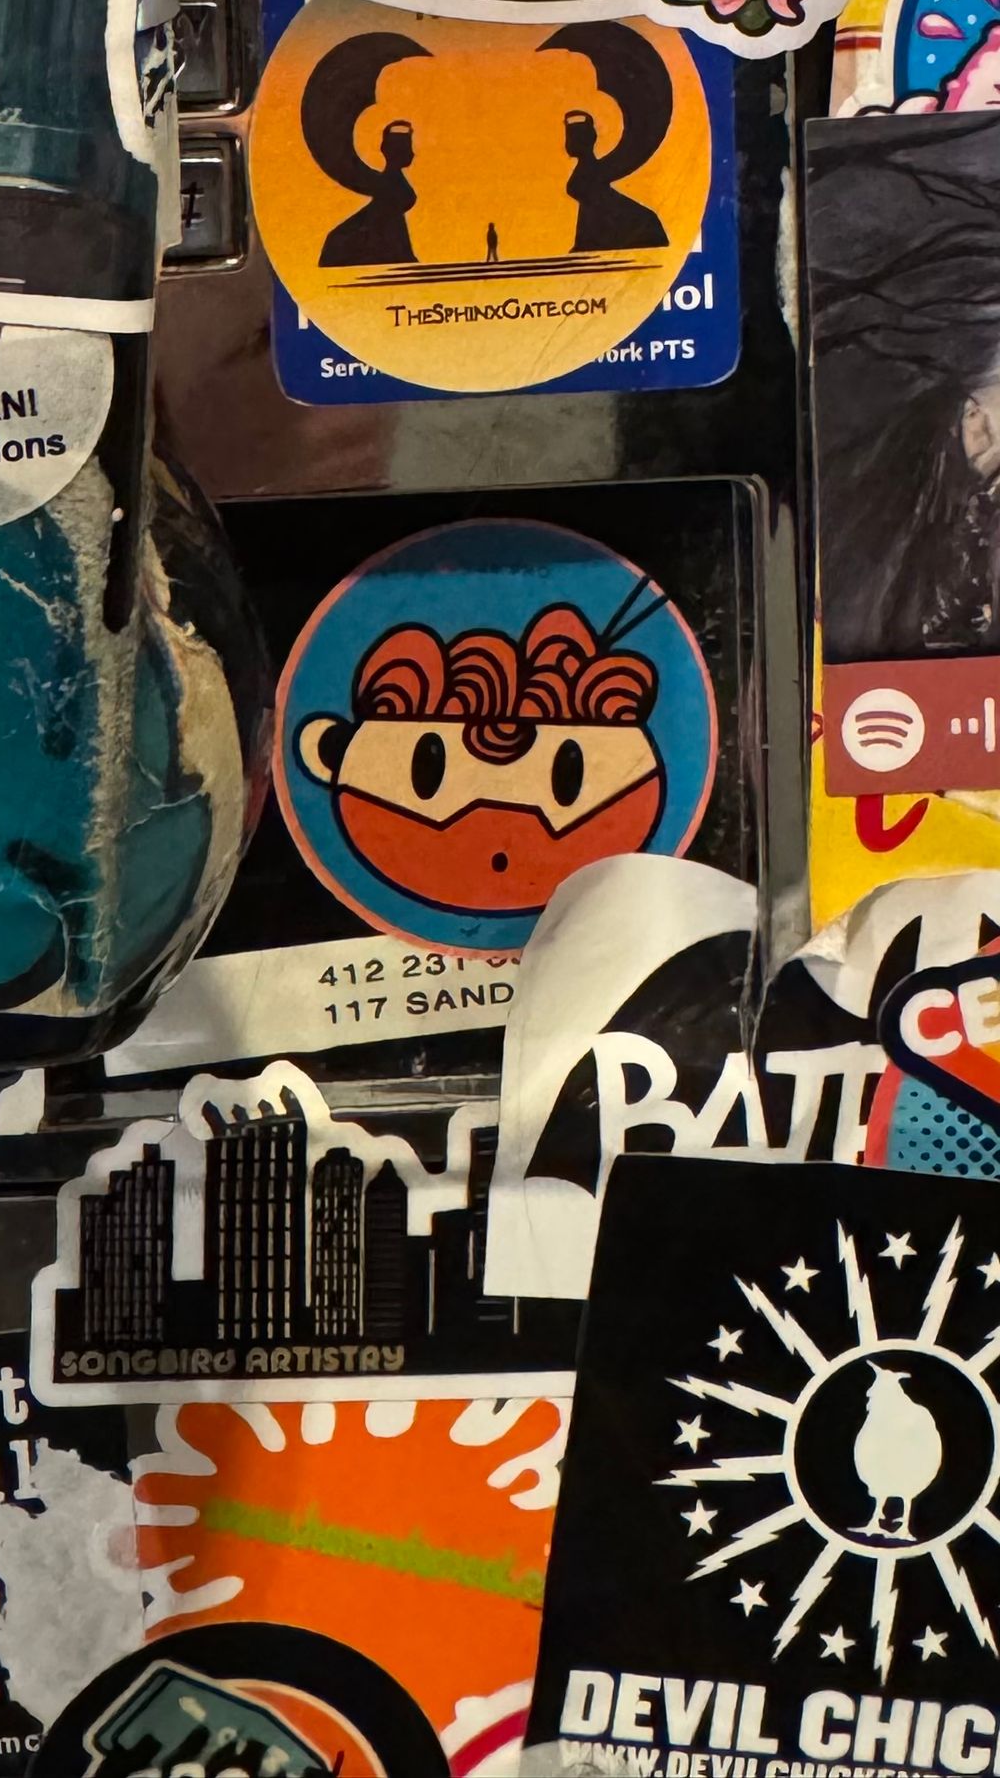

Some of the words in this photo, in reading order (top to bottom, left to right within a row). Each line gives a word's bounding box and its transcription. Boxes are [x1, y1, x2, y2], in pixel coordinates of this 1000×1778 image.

[650, 339, 696, 361] PTS
[318, 959, 384, 987] 412
[325, 997, 387, 1024] 117
[406, 982, 515, 1015] SAND
[60, 1347, 236, 1378] SONGBIRD
[246, 1345, 405, 1375] ARTISTRY
[559, 1669, 779, 1755] DEVIL
[799, 1689, 1000, 1776] CHIC
